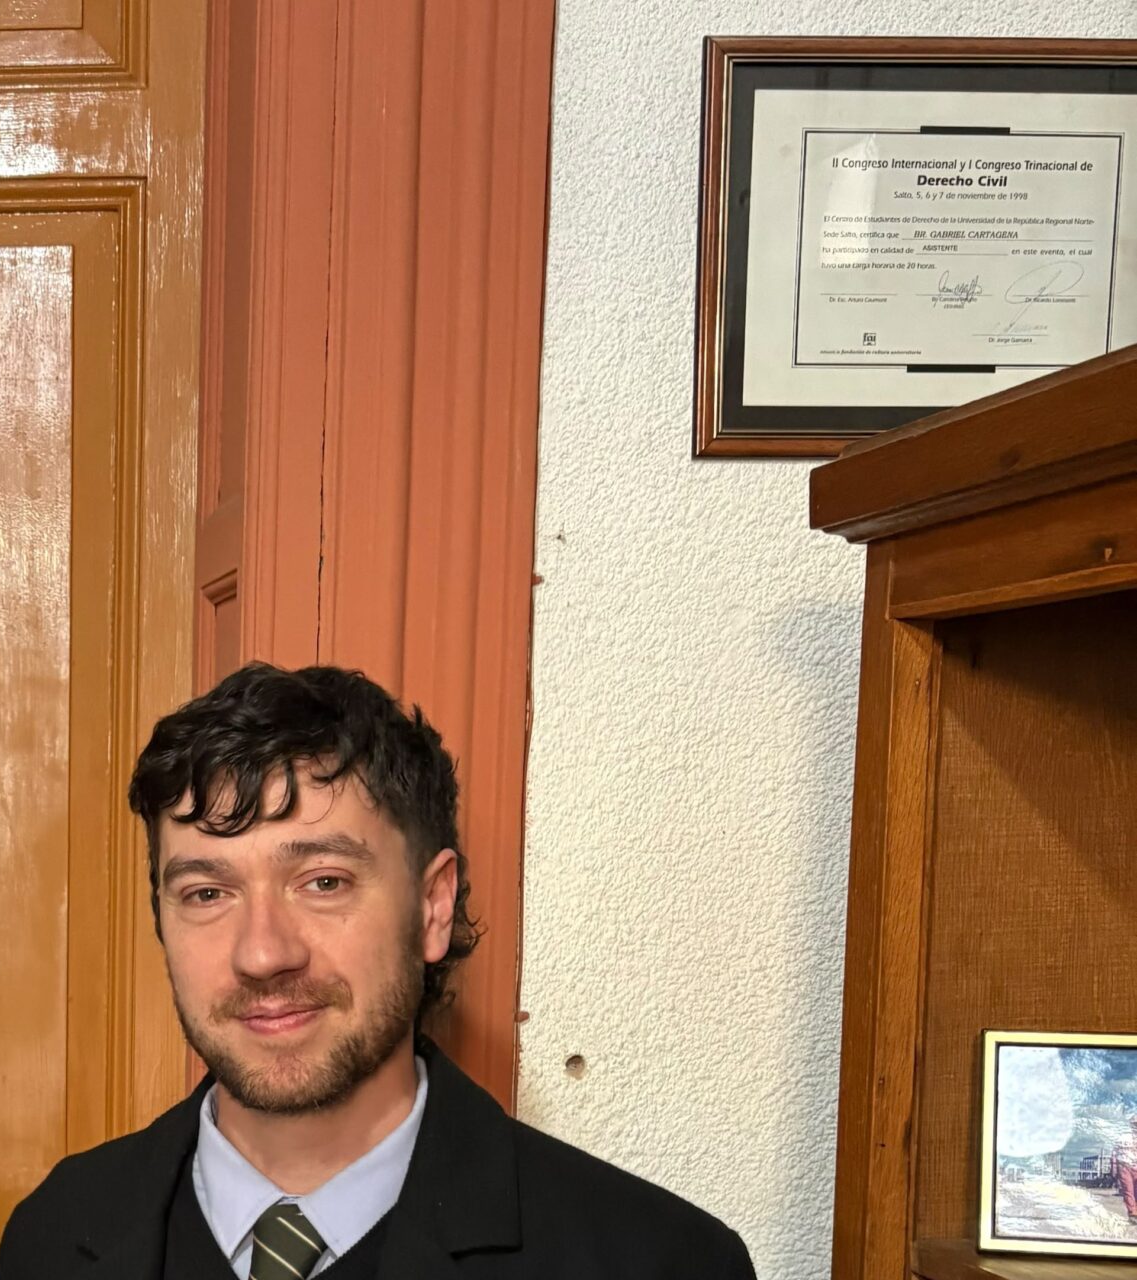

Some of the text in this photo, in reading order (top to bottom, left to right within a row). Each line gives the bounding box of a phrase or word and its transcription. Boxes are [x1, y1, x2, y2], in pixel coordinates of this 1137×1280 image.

[832, 157, 1093, 172] II Congreso Internacional y I Congreso Trinacional de
[917, 175, 1008, 187] Derecho Civil
[894, 191, 913, 199] Salto,
[916, 191, 923, 199] 5,
[925, 191, 931, 199] 6
[932, 193, 937, 201] y
[957, 192, 995, 200] noviembre
[997, 192, 1007, 200] de
[1013, 217, 1044, 226] República
[1045, 218, 1073, 226] Regional
[840, 231, 857, 239] Salto,
[968, 231, 1018, 239] CARTAGENA
